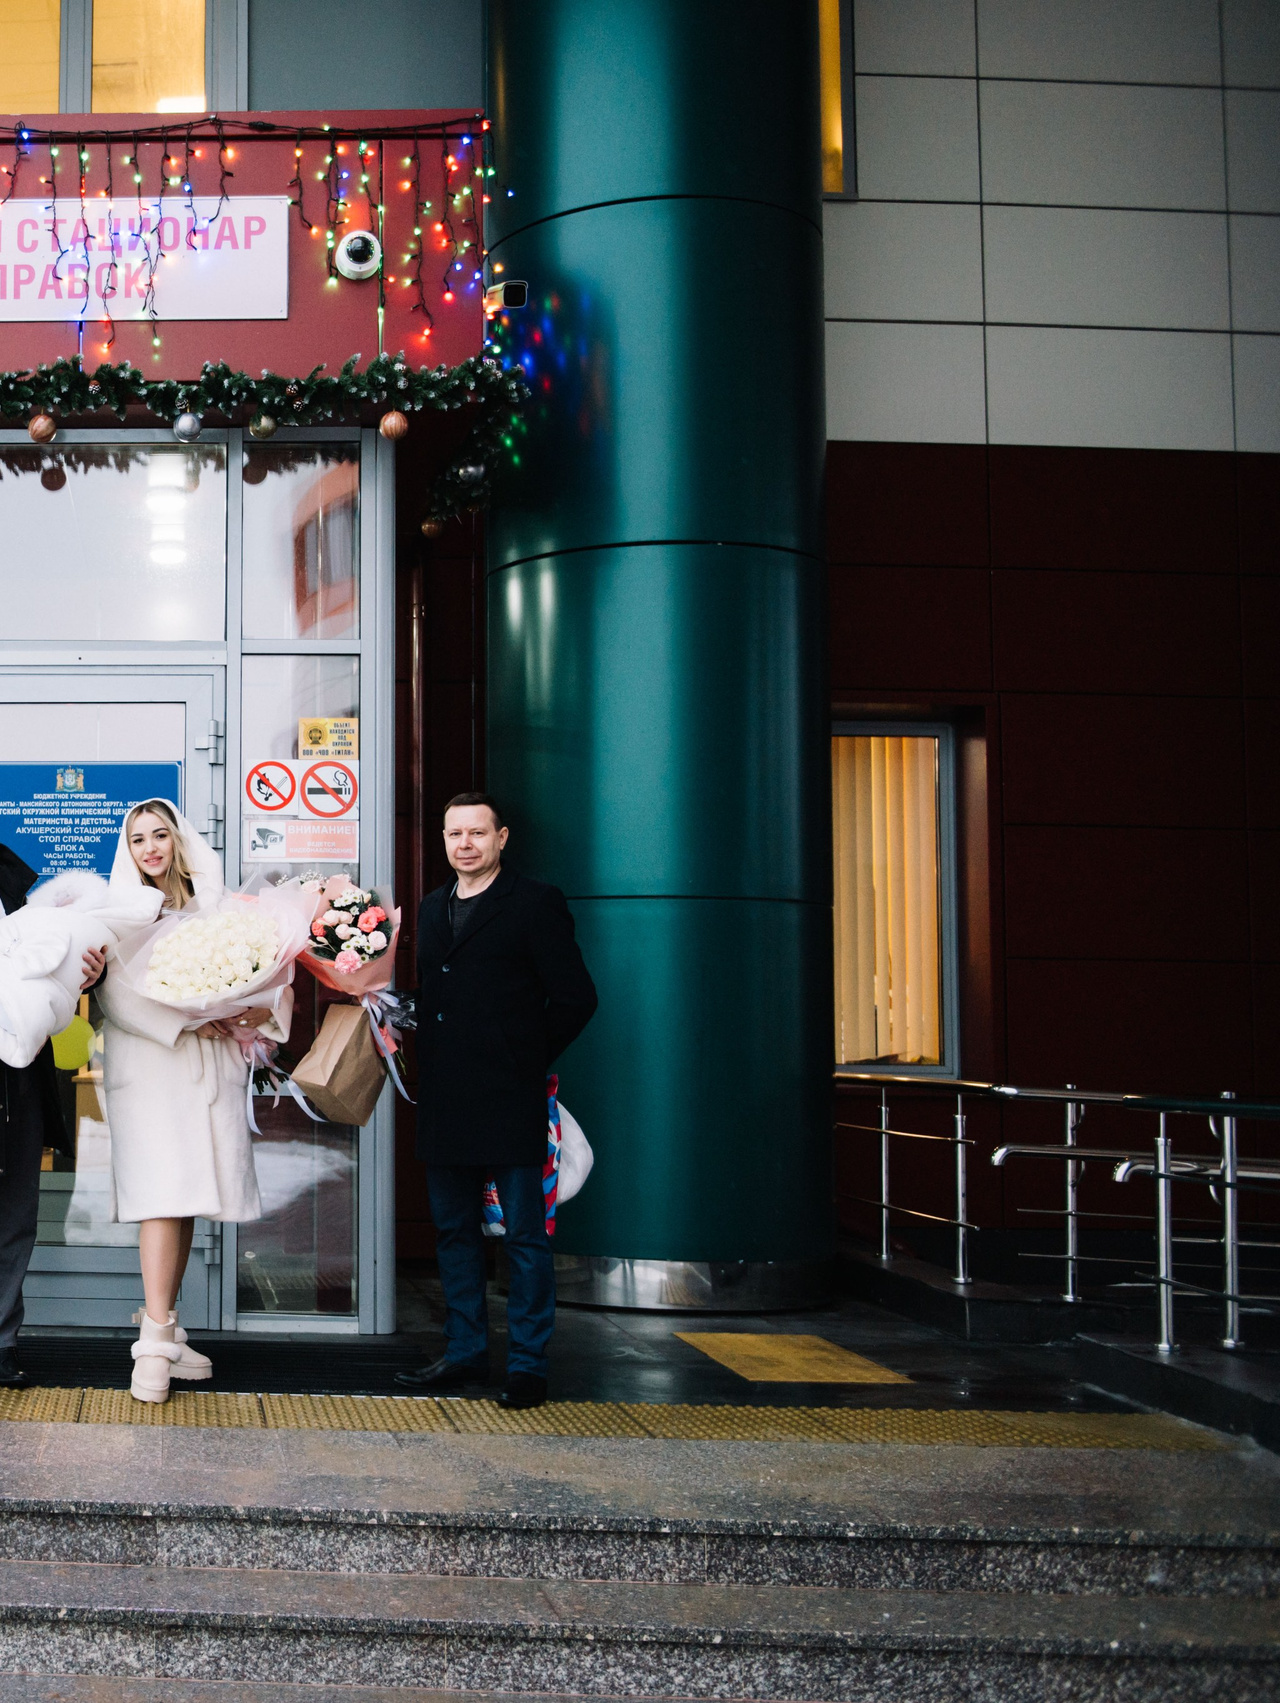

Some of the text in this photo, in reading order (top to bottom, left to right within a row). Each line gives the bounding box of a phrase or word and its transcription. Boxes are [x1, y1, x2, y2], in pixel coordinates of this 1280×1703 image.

[16, 215, 267, 257] СТАЦИОНАР
[22, 807, 60, 815] ОКРУЖНОЙ
[61, 807, 111, 815] КЛИНИЧЕСКИЙ
[23, 817, 116, 826] МАТЕРИНСТВА И ДЕТСТВА»
[16, 825, 72, 834] АКУШЕРСКИЙ
[288, 825, 355, 835] ВНИМАНИЕ!
[38, 835, 101, 843] СТОЛ СПРАВОК
[54, 844, 85, 852] БЛОК А
